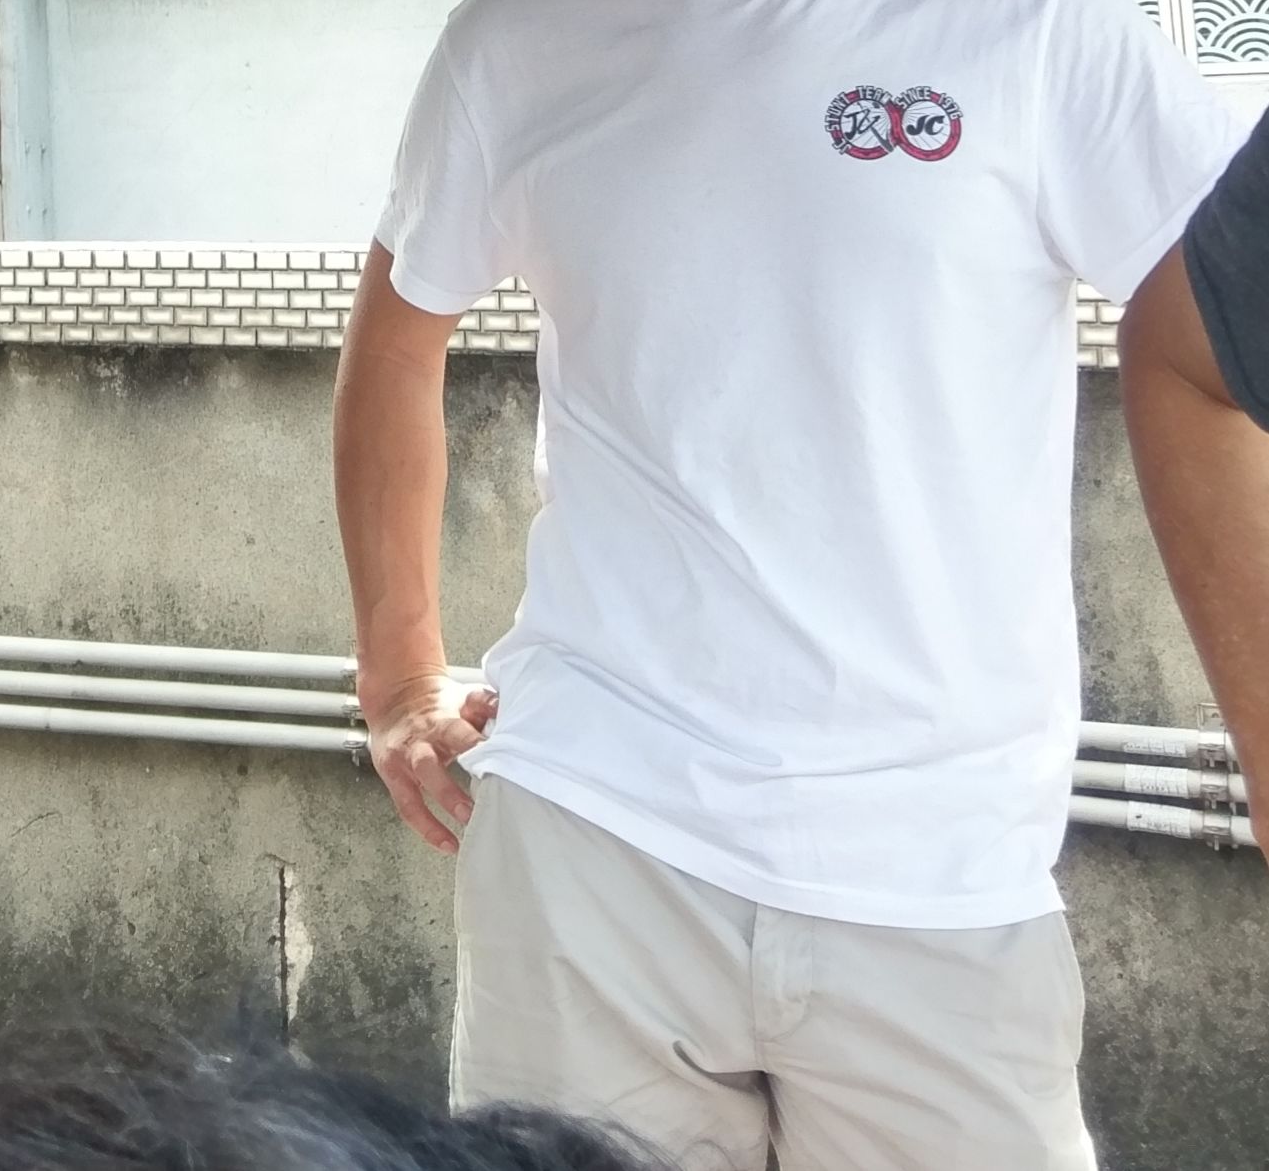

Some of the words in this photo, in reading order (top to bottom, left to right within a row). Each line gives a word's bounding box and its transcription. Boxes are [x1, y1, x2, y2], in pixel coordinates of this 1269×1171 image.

[825, 91, 851, 133] STUNT
[855, 85, 893, 104] TEAM
[893, 85, 932, 110] SINCE
[938, 92, 964, 120] 1976
